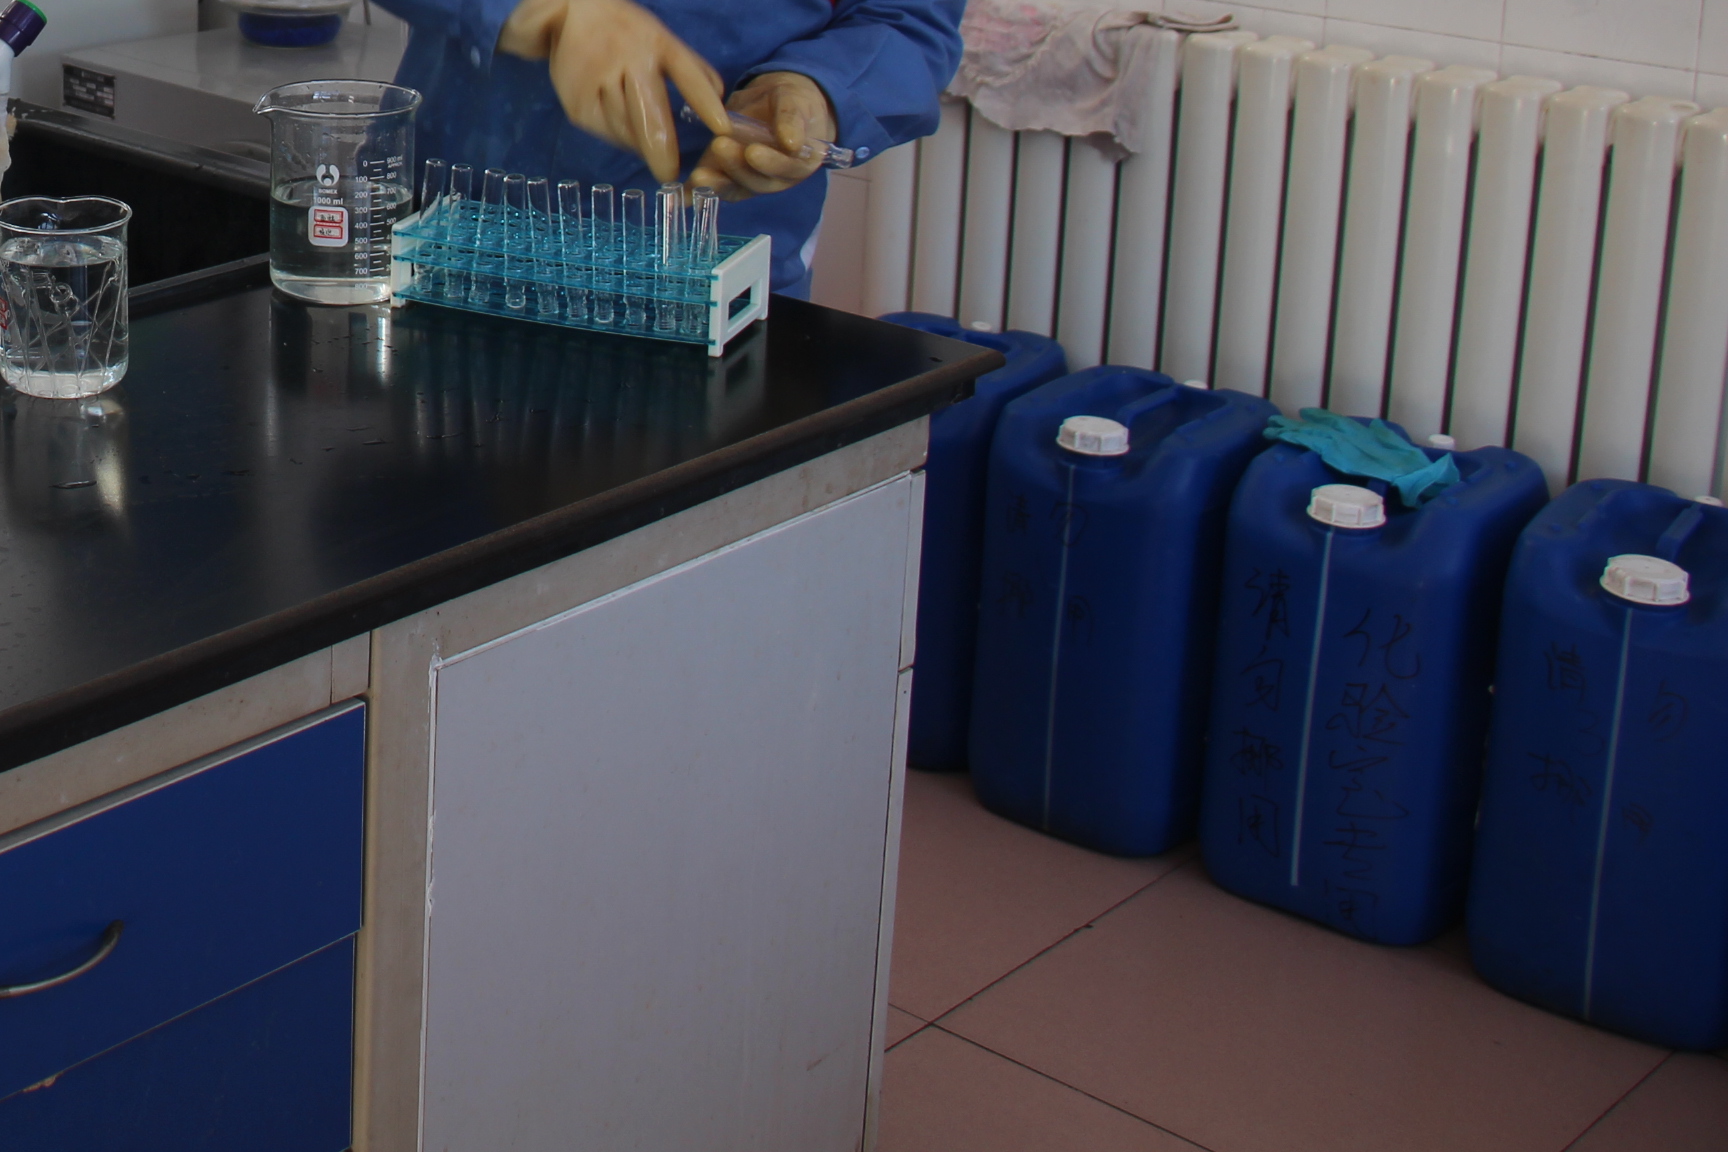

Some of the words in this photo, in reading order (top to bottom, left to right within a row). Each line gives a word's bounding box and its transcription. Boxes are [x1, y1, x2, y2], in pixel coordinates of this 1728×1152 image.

[314, 196, 331, 205] 1000
[333, 197, 344, 205] ml
[355, 252, 368, 260] 600
[355, 267, 368, 275] 700
